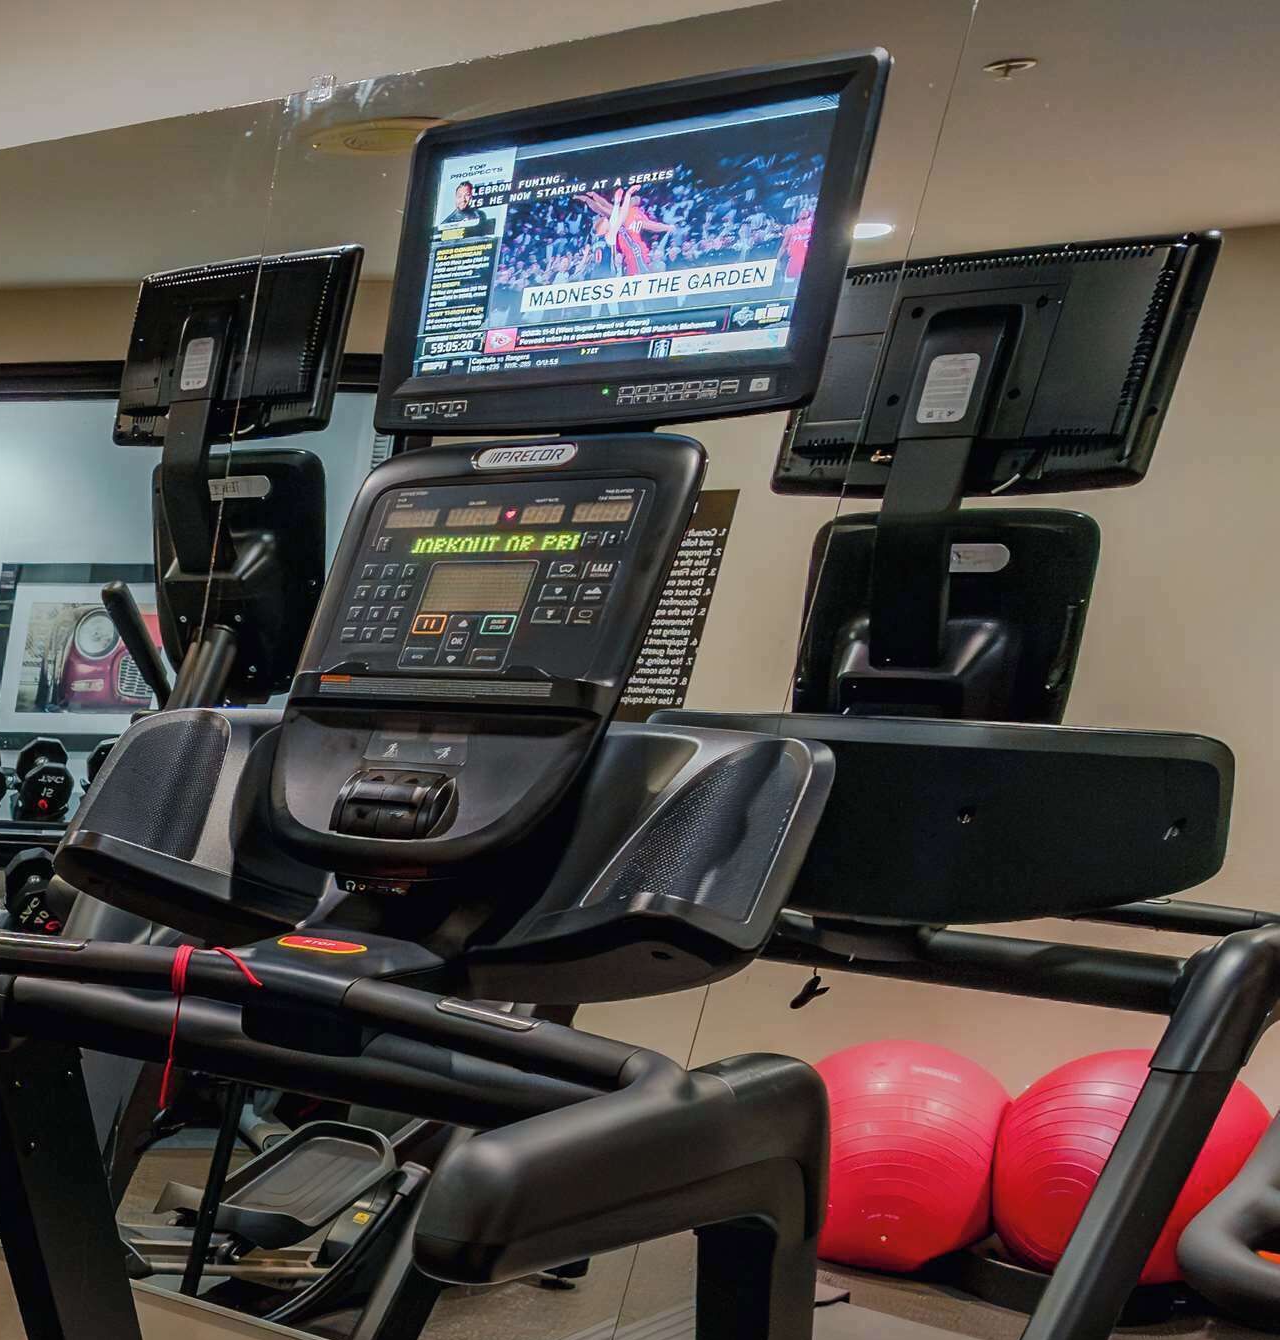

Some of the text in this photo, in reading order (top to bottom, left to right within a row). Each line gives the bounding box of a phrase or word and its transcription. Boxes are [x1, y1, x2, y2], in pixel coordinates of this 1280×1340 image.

[450, 167, 503, 180] PROSPECTS
[468, 164, 487, 172] TOP
[472, 175, 565, 196] LEBRON FUMING.
[489, 194, 503, 205] HE
[509, 191, 531, 203] NOW
[536, 184, 586, 200] STARING
[592, 179, 608, 190] AT
[613, 178, 622, 187] A
[628, 170, 674, 185] SERIES
[529, 266, 767, 307] MADNESS AT THE GARDEN
[431, 340, 474, 354] 59:05:20
[491, 446, 565, 464] PRECOR
[450, 637, 464, 646] OK
